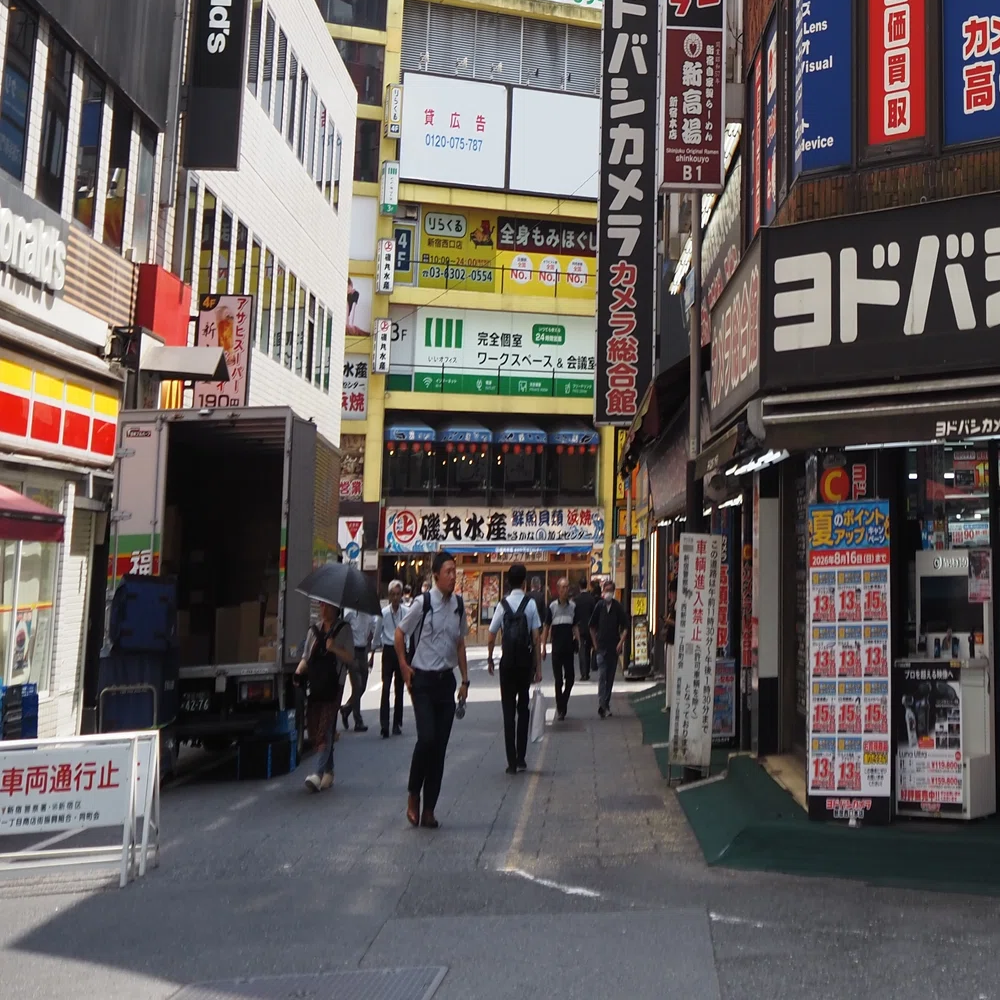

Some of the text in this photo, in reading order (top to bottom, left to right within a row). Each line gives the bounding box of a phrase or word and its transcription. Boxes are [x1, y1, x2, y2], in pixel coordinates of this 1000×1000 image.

[803, 18, 828, 35] Lens
[669, 96, 678, 140] 新宿本店
[425, 134, 483, 152] 0120-075-787
[676, 155, 709, 164] shinkouyo
[428, 217, 463, 234] りらくる
[427, 238, 462, 250] 新宿西口店
[510, 268, 532, 280] No.1
[567, 273, 588, 284] No.1
[202, 299, 216, 309] 4F
[231, 298, 248, 394] アサヒスーパー
[477, 332, 522, 348] 完全個室
[607, 260, 637, 417] カメラ総合館
[477, 352, 552, 367] ワークスペース
[556, 358, 563, 368] &
[511, 507, 592, 527] 鮮魚貝類 浜焼
[419, 512, 507, 542] 磯丸水産
[0, 760, 119, 797] 車両通行止
